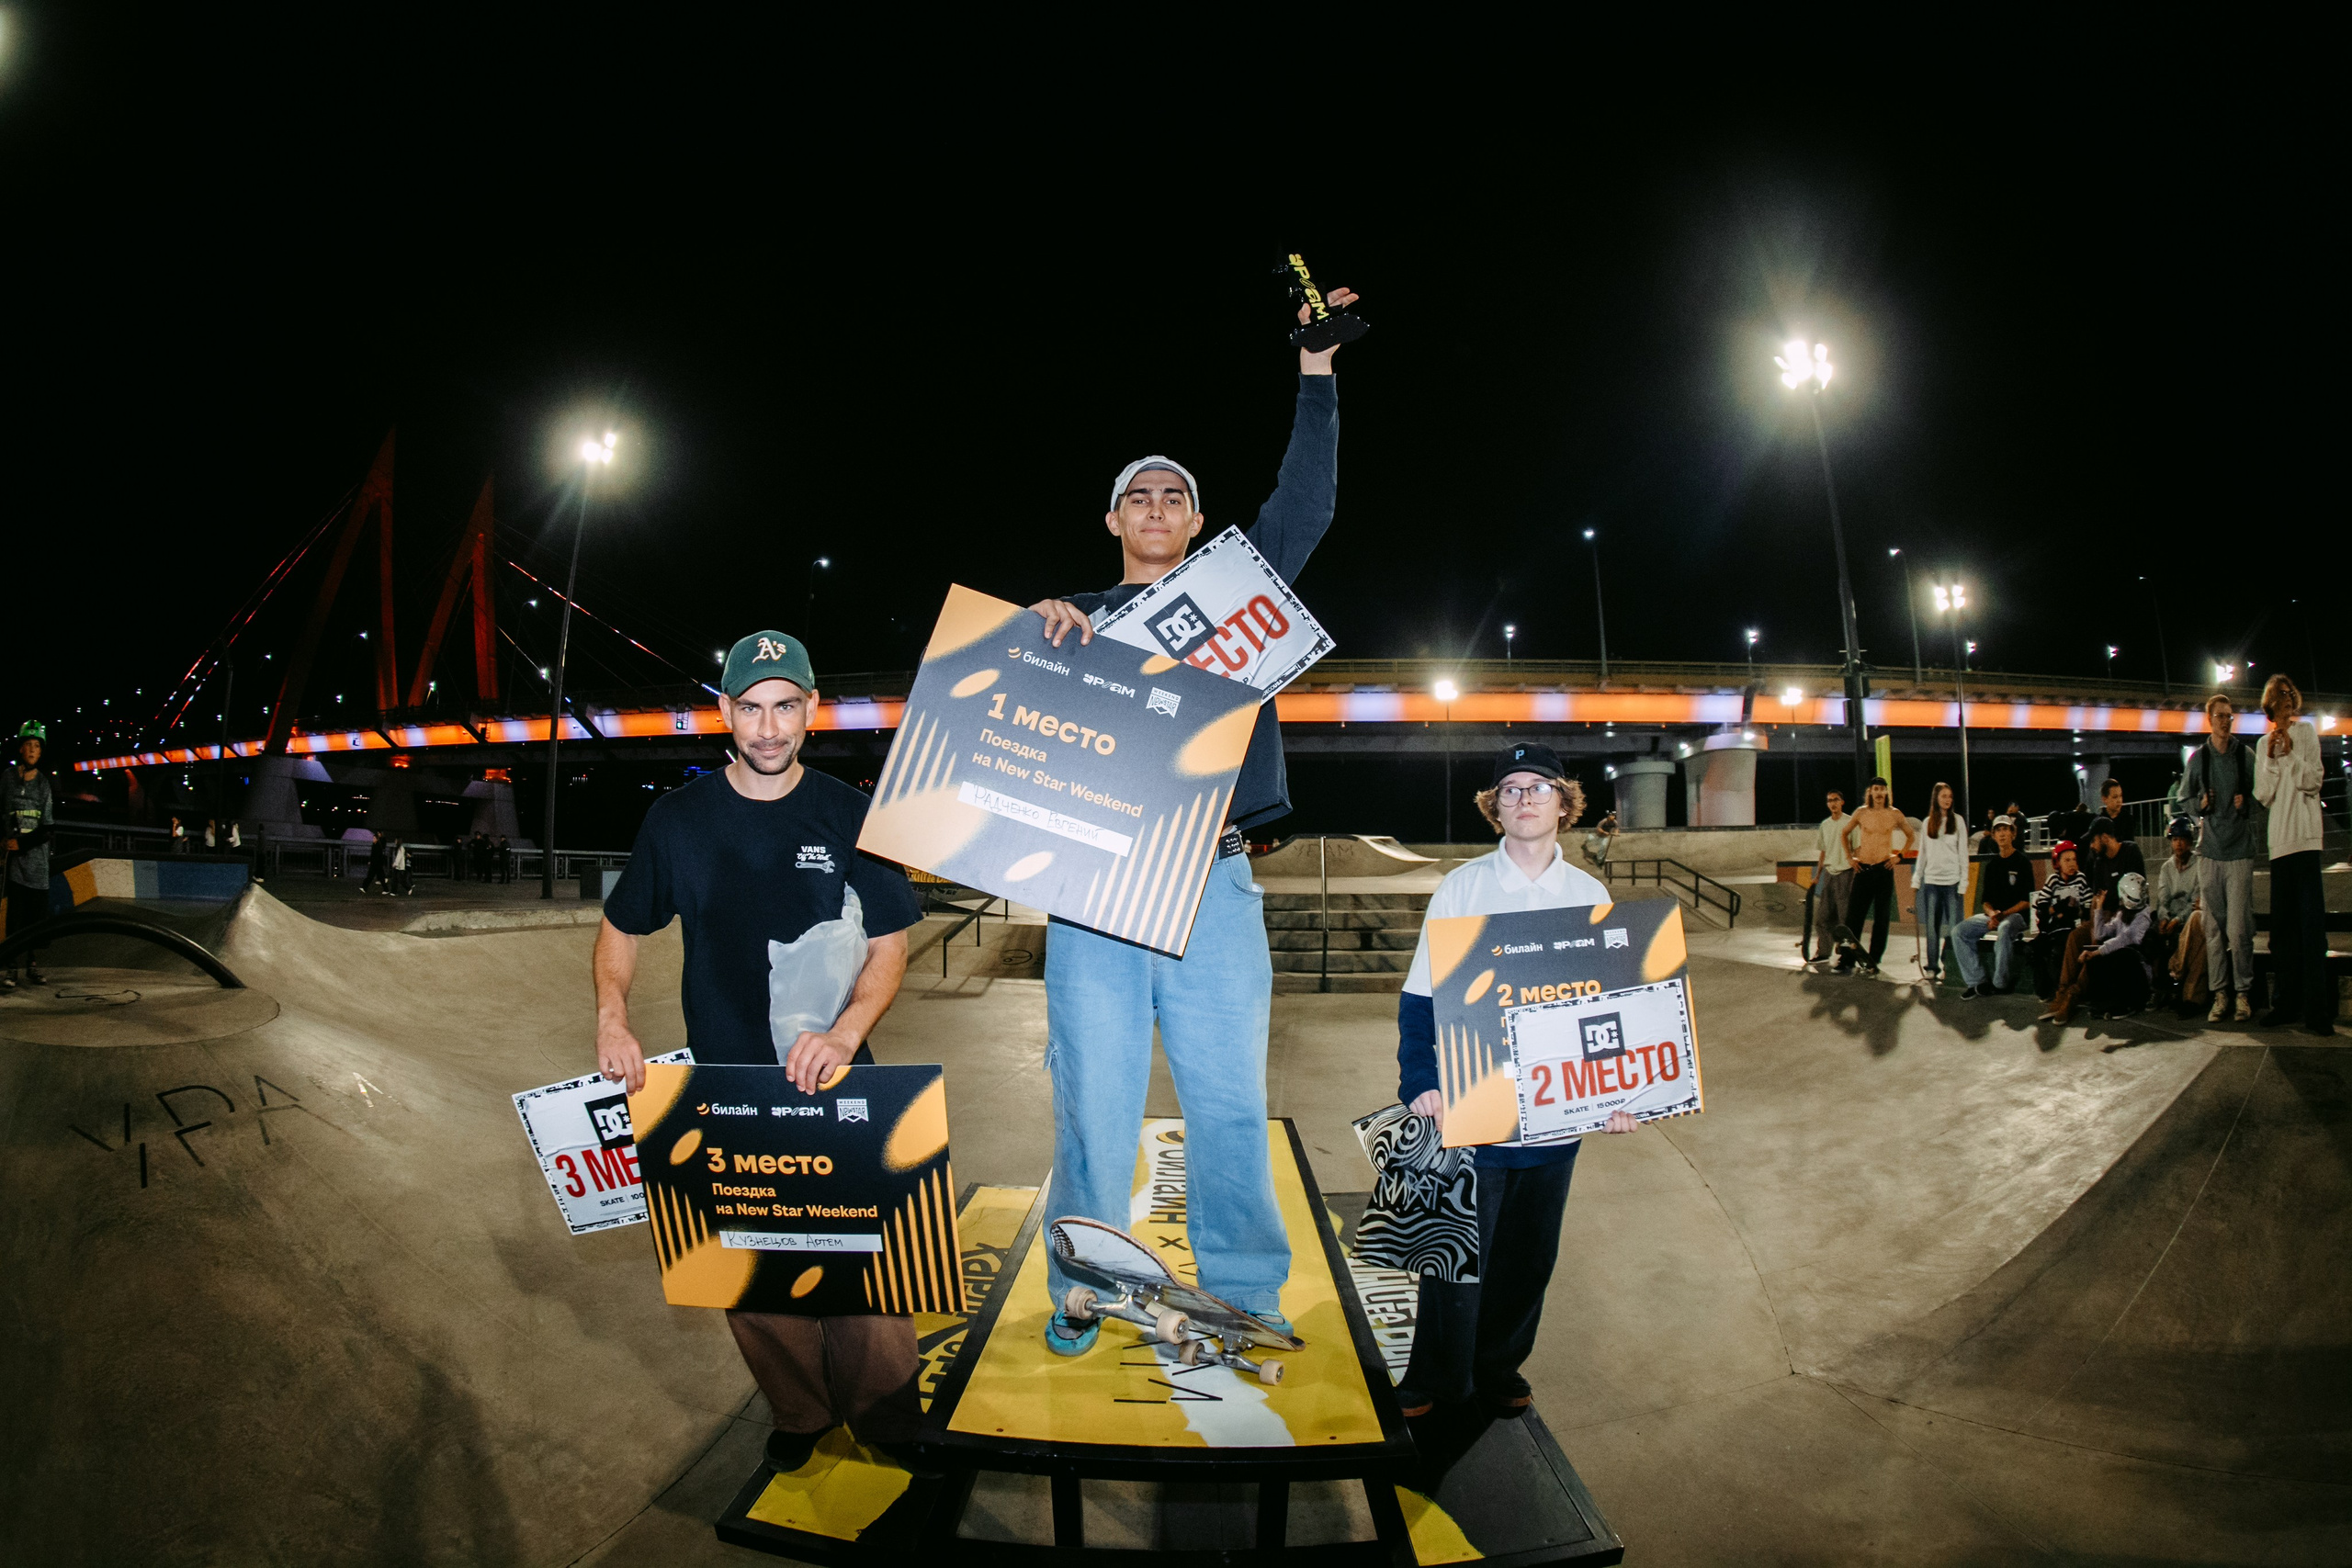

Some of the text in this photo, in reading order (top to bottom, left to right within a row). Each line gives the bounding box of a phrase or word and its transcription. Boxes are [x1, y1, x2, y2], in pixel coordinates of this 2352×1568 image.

[1023, 650, 1070, 676] билайн
[1153, 688, 1180, 701] WEEKEND
[987, 693, 1116, 756] 1 место
[979, 728, 1047, 763] Поездка
[972, 751, 1144, 818] на New Star Weekend
[800, 845, 827, 854] VANS
[1504, 942, 1544, 954] билайн
[1497, 979, 1602, 1007] 2 место
[1531, 1041, 1681, 1108] 2 МЕСТО
[711, 1103, 759, 1116] билайн
[1564, 1105, 1590, 1116] SKATE
[707, 1147, 833, 1176] 3 место
[555, 1154, 587, 1198] 3
[712, 1182, 777, 1199] Поездка
[599, 1196, 625, 1207] SKATE
[716, 1202, 878, 1218] на New Star Weekend
